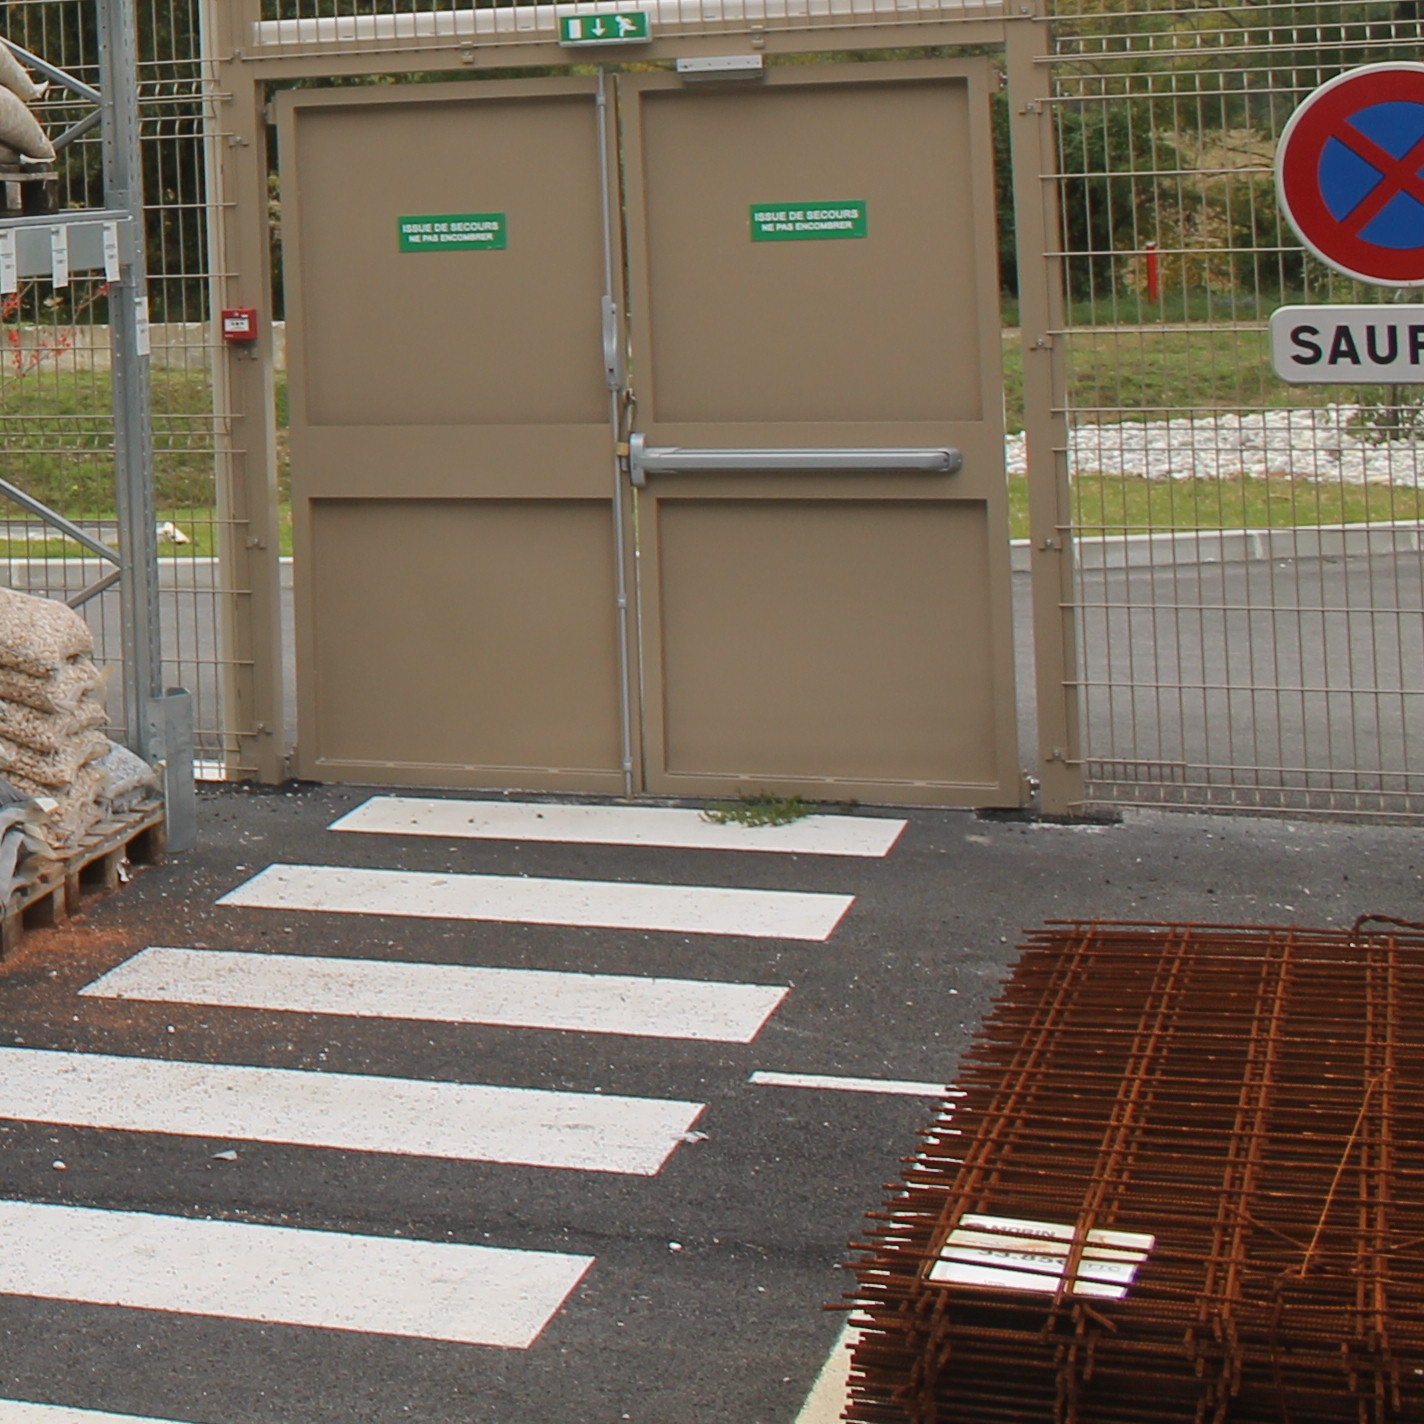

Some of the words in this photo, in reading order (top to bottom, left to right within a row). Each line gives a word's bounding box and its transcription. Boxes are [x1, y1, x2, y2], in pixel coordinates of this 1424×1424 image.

[754, 211, 787, 221] ISSUE
[788, 211, 805, 220] DE
[806, 209, 859, 220] SECOURS
[402, 222, 433, 233] ISSUE
[434, 222, 449, 232] DE
[450, 221, 499, 232] SECOURS
[761, 223, 775, 232] NE
[776, 223, 794, 231] PAS
[795, 221, 853, 231] ENCOMBRER
[408, 234, 421, 243] NE
[422, 234, 439, 242] PAS
[440, 232, 494, 242] ENCOMBRER
[1086, 1263, 1121, 1273] TTC
